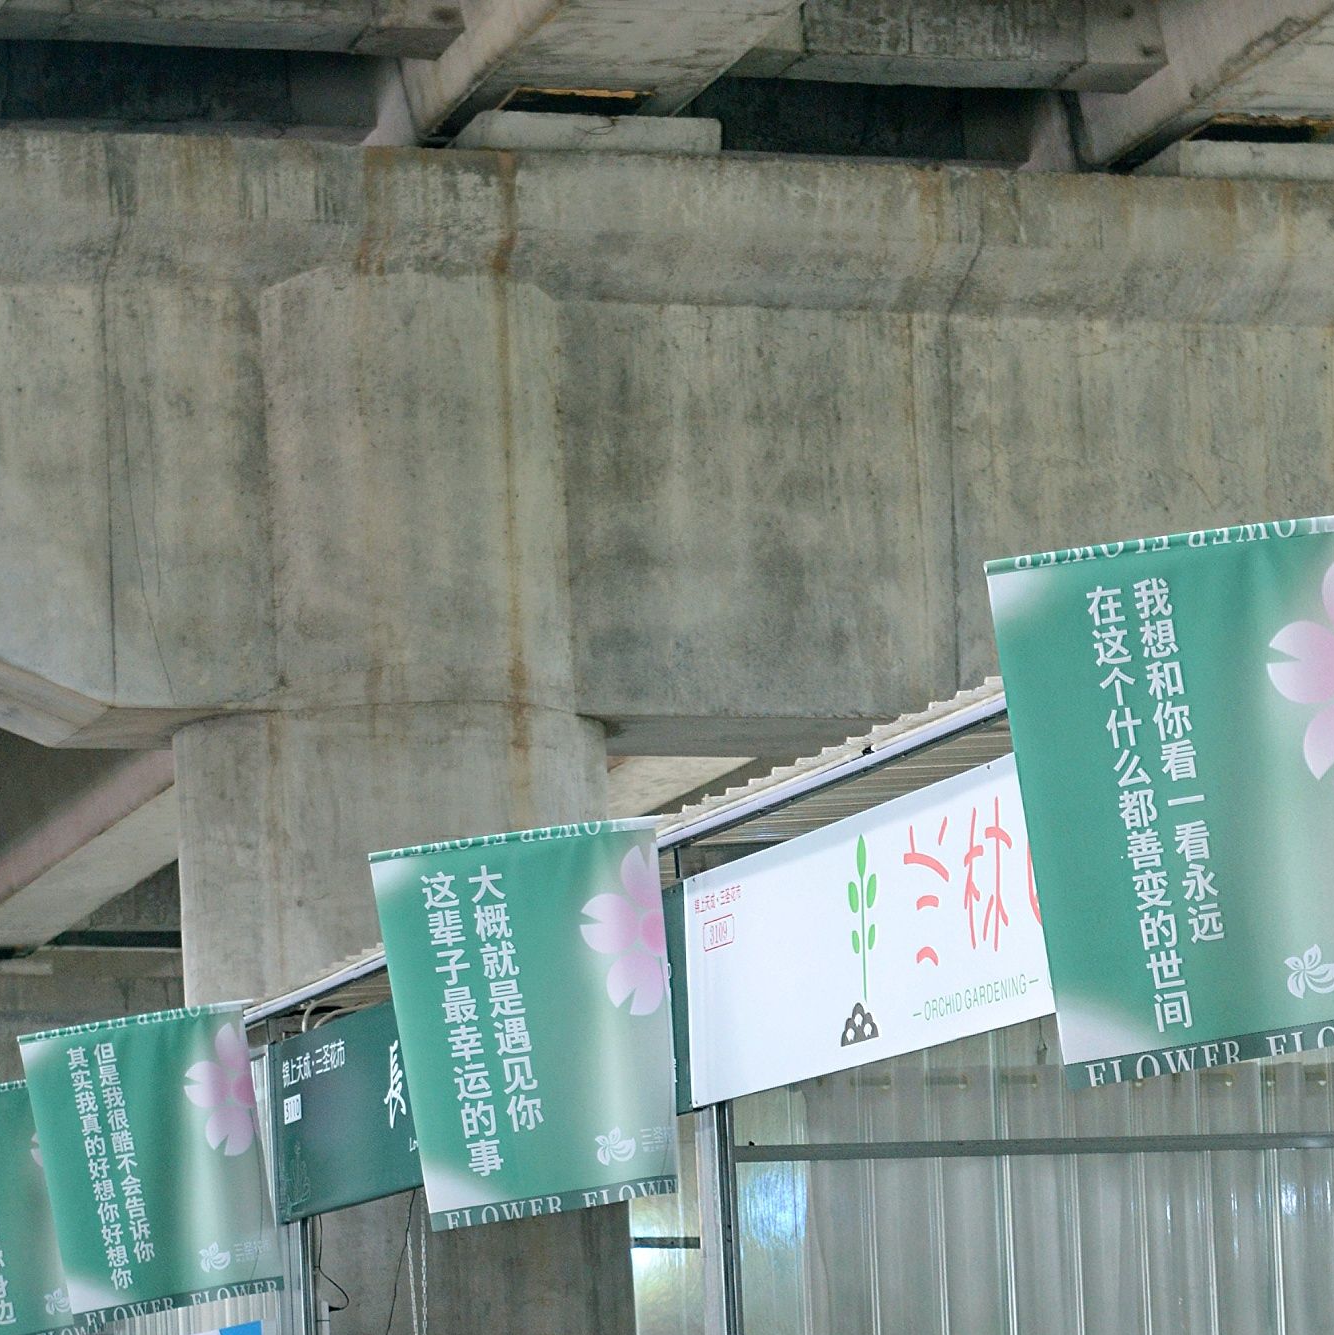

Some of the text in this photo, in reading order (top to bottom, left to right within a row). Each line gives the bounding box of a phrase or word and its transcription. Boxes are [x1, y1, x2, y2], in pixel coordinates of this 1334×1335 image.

[1086, 585, 1193, 1033] 在这个什么都善变的世间
[1134, 577, 1224, 944] 我想和你看一看永远
[420, 871, 504, 1177] 这辈子最幸运的事
[468, 865, 544, 1132] 大概就是遇见你
[924, 974, 1027, 1021] ORCHID GARDENING
[1085, 1041, 1240, 1087] FLOWER
[67, 1046, 133, 1290] 其实我真的好想你好想你
[93, 1043, 156, 1265] 但是我很酷不会告诉你
[285, 1099, 301, 1121] 3110
[444, 1195, 562, 1231] FLOWER
[85, 1279, 279, 1327] FLOWER FLOWER
